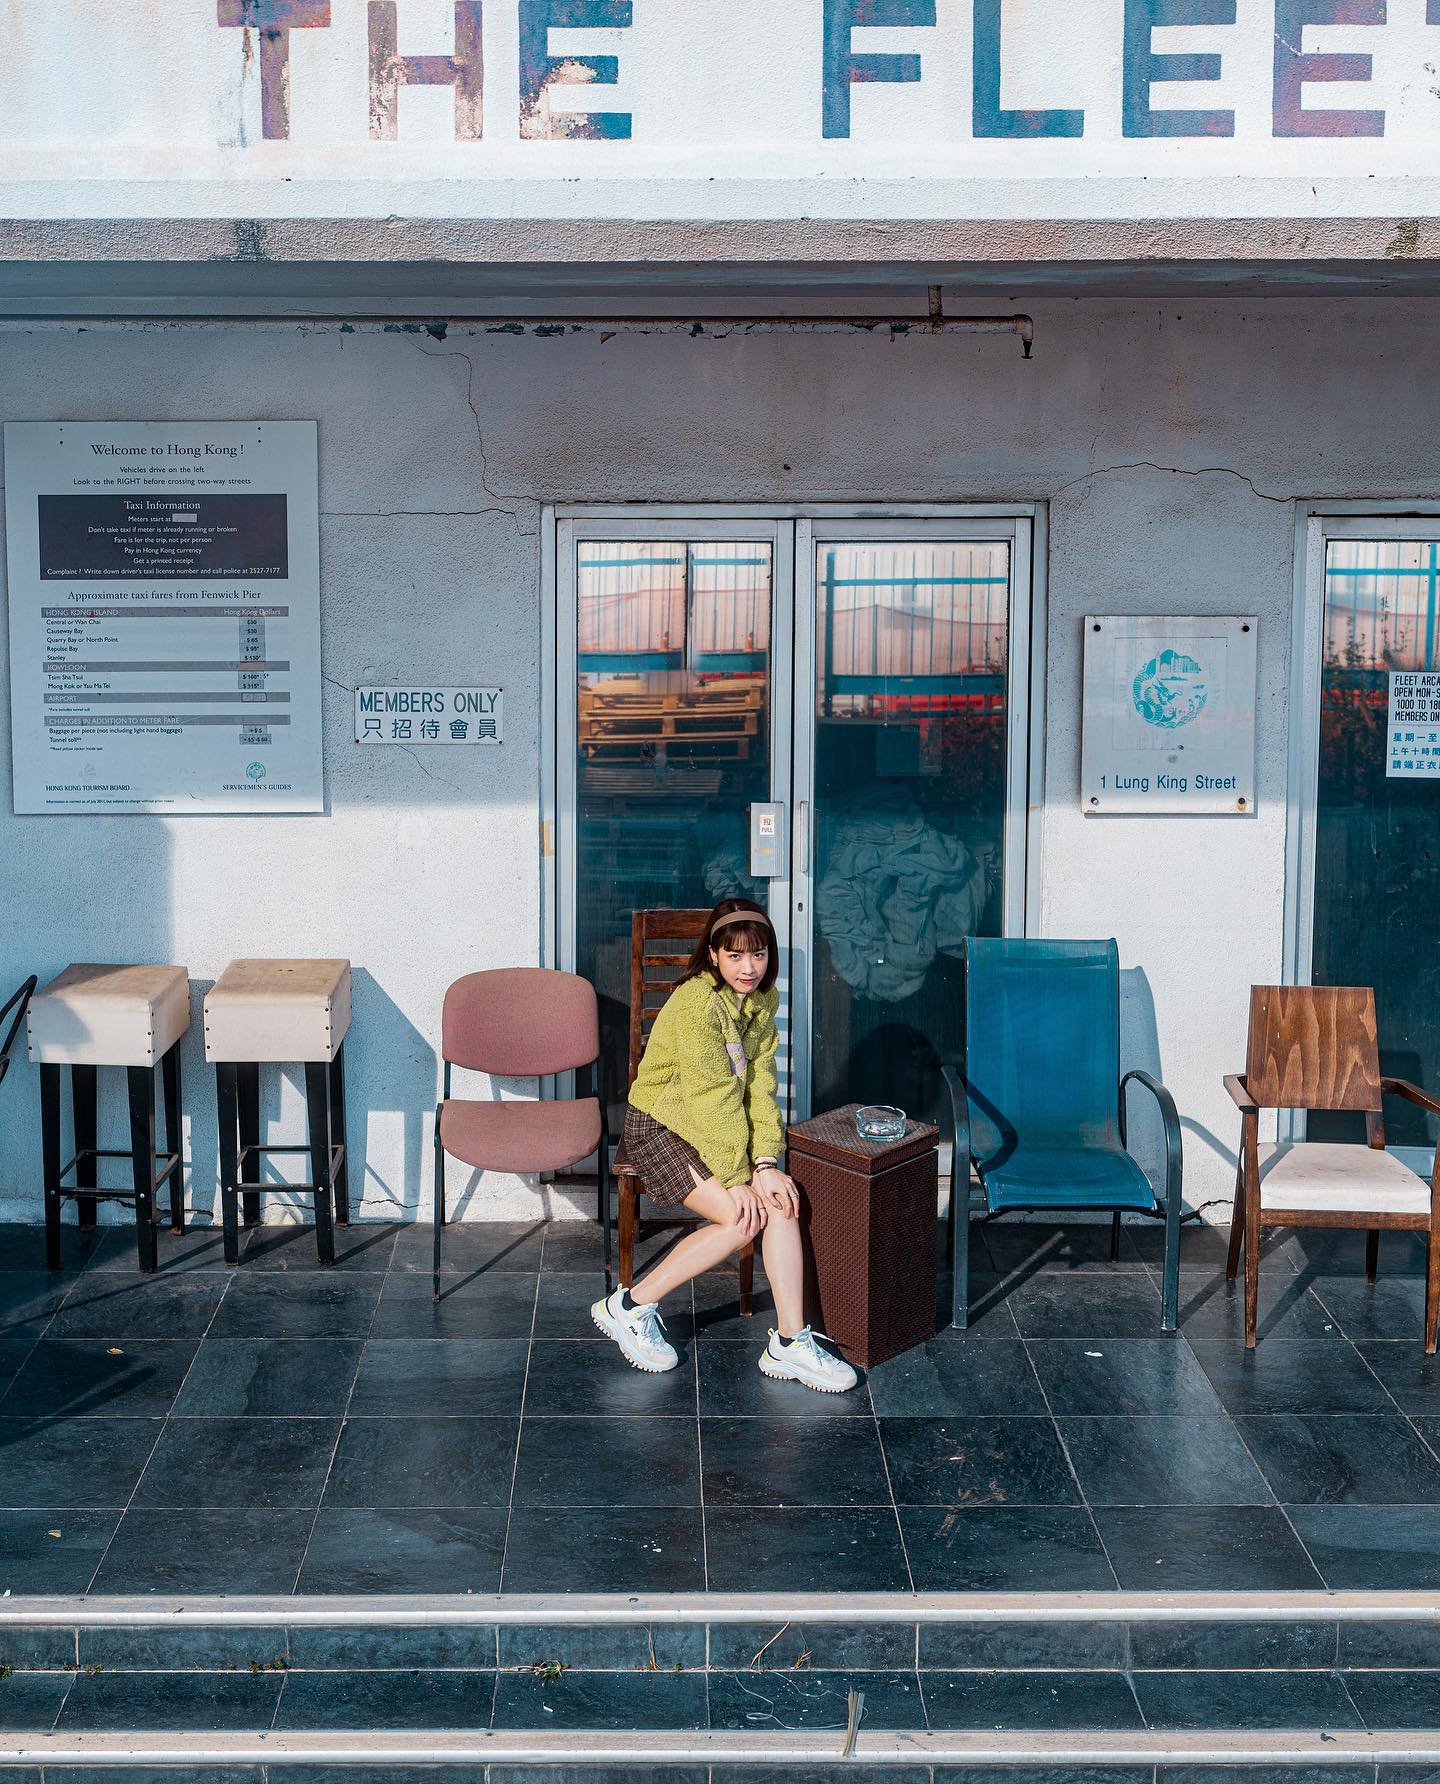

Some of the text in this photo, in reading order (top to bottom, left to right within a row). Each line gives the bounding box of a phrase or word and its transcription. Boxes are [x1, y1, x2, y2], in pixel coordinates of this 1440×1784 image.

[216, 0, 1440, 140] THE FLEE
[91, 444, 147, 455] Welcome
[151, 445, 164, 455] to
[167, 444, 201, 458] Hong
[205, 444, 237, 458] Kong
[168, 478, 195, 486] crossing
[198, 478, 225, 486] two-way
[124, 500, 200, 510] Taxi Information
[68, 590, 261, 602] Approximate taxi fares from Fenwick Pier
[1395, 676, 1418, 686] FLEET
[1394, 687, 1413, 697] OPEN
[360, 692, 498, 713] MEMBERS ONLY
[1398, 699, 1414, 709] 1000
[1418, 700, 1426, 709] TO
[1395, 711, 1428, 721] MEMBERS
[362, 718, 498, 740] 只招待會員
[1392, 760, 1440, 769] 請端正衣
[1100, 774, 1236, 792] 1 Lung King Street
